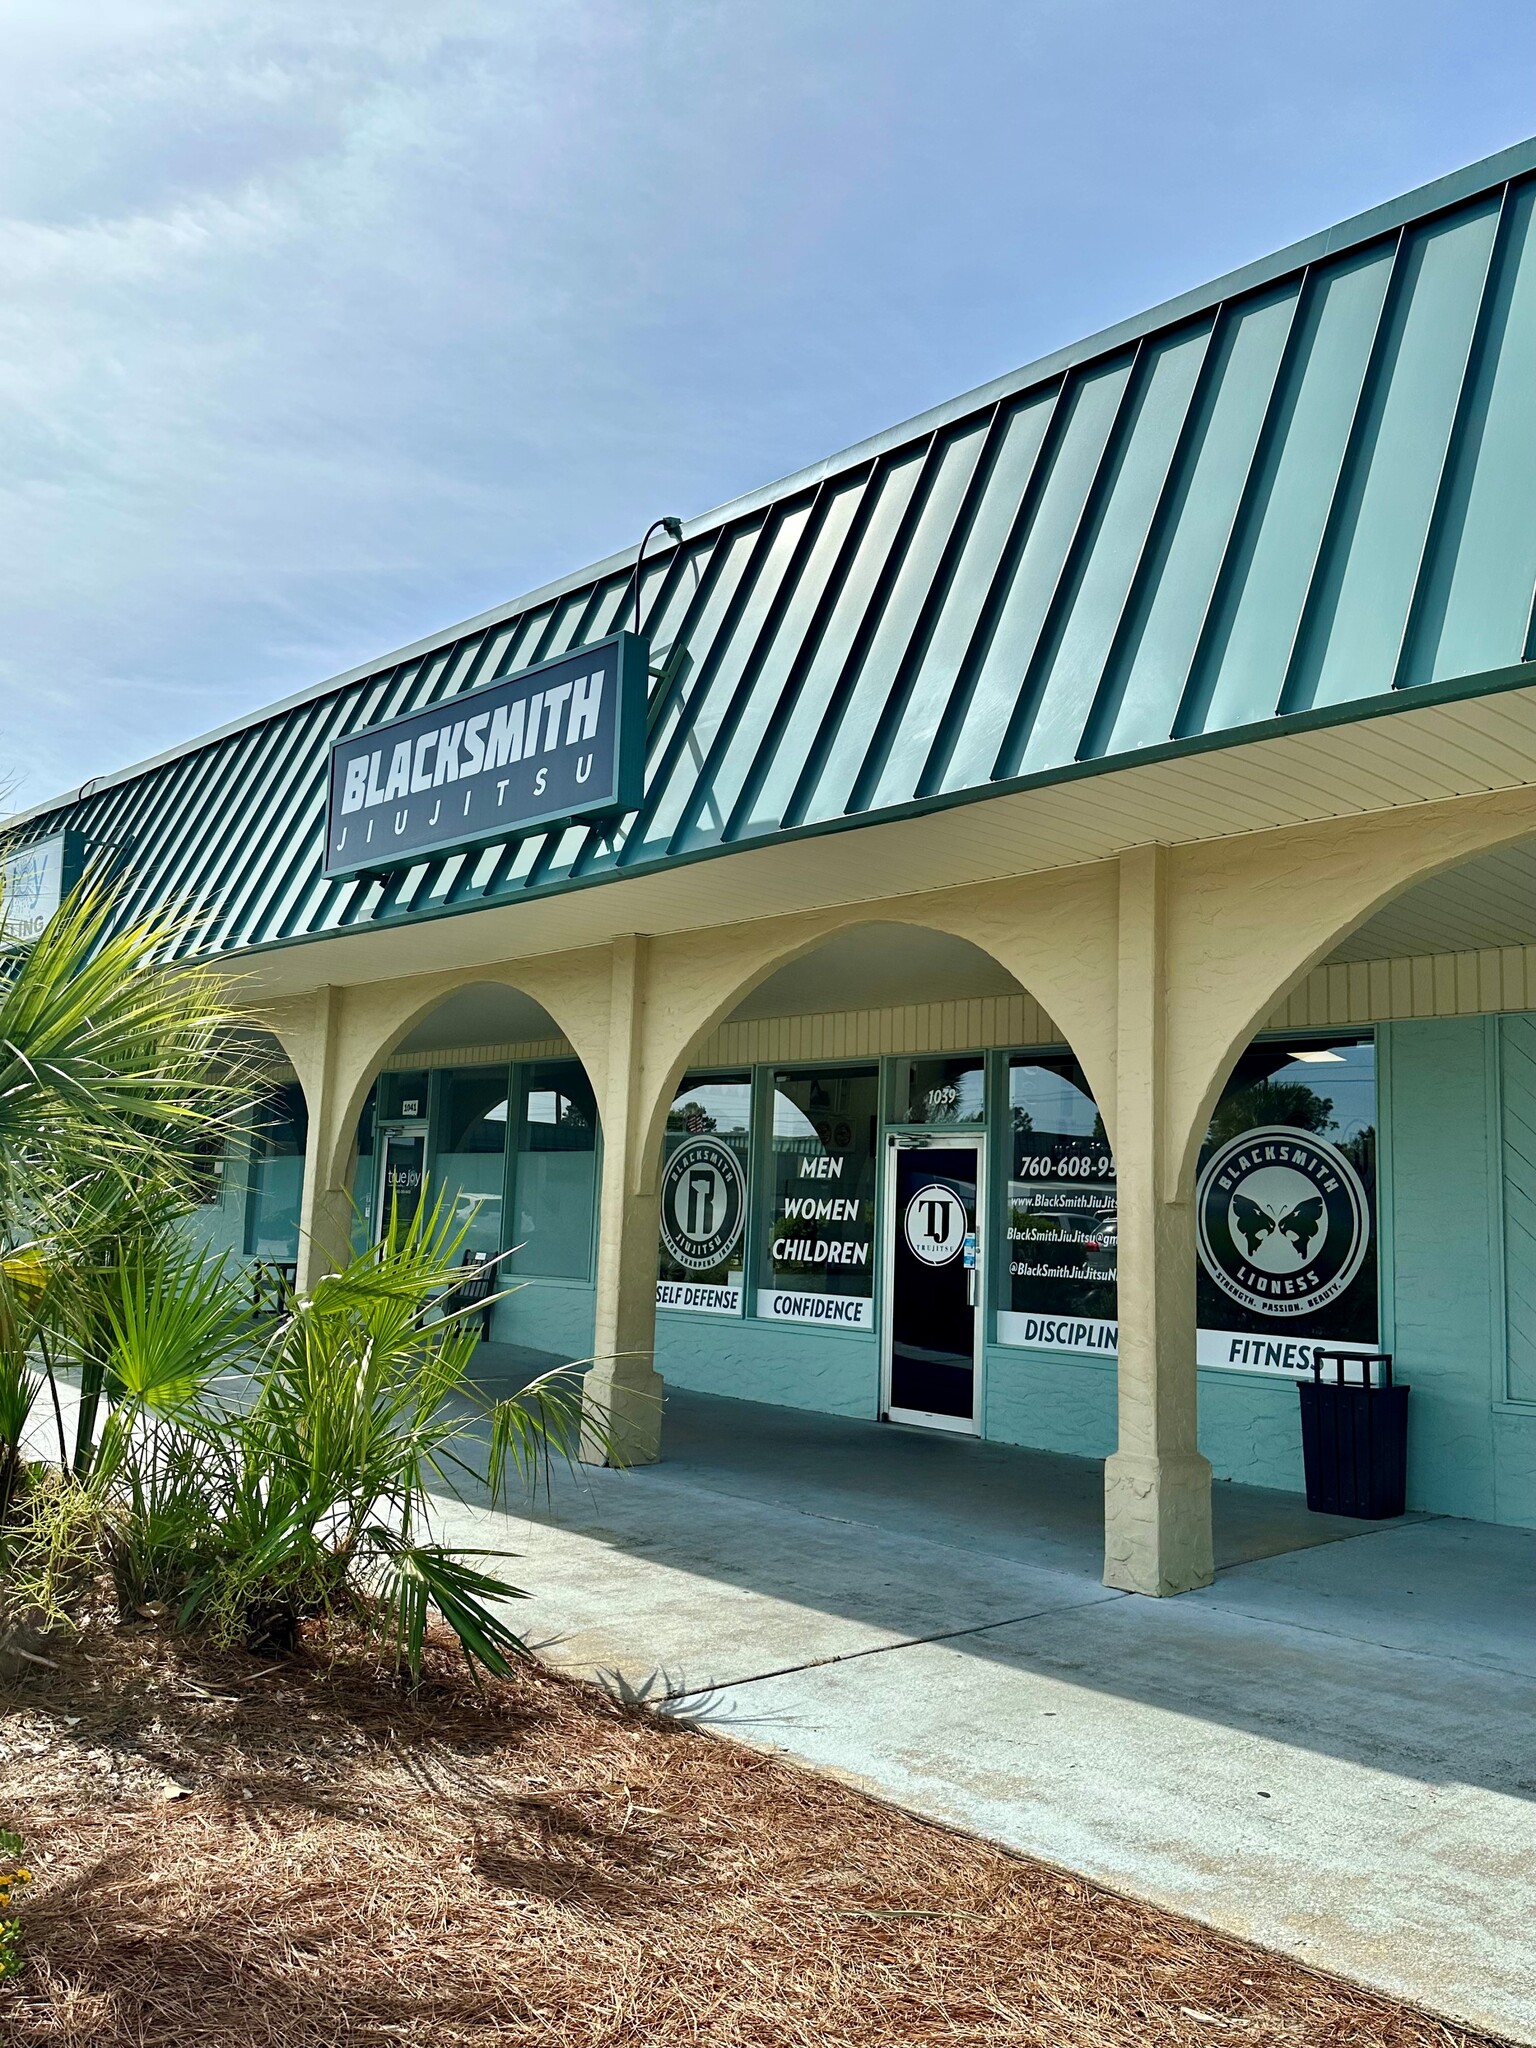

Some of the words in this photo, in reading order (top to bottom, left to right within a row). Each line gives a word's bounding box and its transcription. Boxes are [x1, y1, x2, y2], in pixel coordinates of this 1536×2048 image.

[341, 669, 605, 816] BLACKSMITH
[404, 1103, 417, 1111] 1041
[928, 1088, 956, 1104] 1039
[671, 1150, 734, 1182] BLACKSMITH
[800, 1157, 843, 1178] MEN
[1020, 1156, 1117, 1177] 760-608-95
[1218, 1146, 1339, 1193] BLACKSMITH
[784, 1198, 859, 1221] WOMEN
[1011, 1194, 1117, 1209] www.BlackSmithJiuJits
[918, 1200, 954, 1244] TJ
[675, 1233, 722, 1255] JIUJITSU
[916, 1244, 955, 1252] TRUJITSU
[1007, 1227, 1117, 1247] BlackSmithJiuJitsu@gm
[772, 1239, 868, 1264] CHILDREN
[1009, 1261, 1117, 1282] @BlackSmithJiuJitsuN
[1236, 1266, 1320, 1295] LIONESS
[655, 1285, 682, 1304] SELF
[685, 1287, 739, 1310] DEFENSE
[1215, 1271, 1257, 1307] STRENGTH.
[1261, 1302, 1304, 1312] PASSION.
[1307, 1282, 1342, 1308] BEAUTY.
[773, 1295, 863, 1322] CONFIDENCE
[1024, 1319, 1118, 1350] DISCIPLIN
